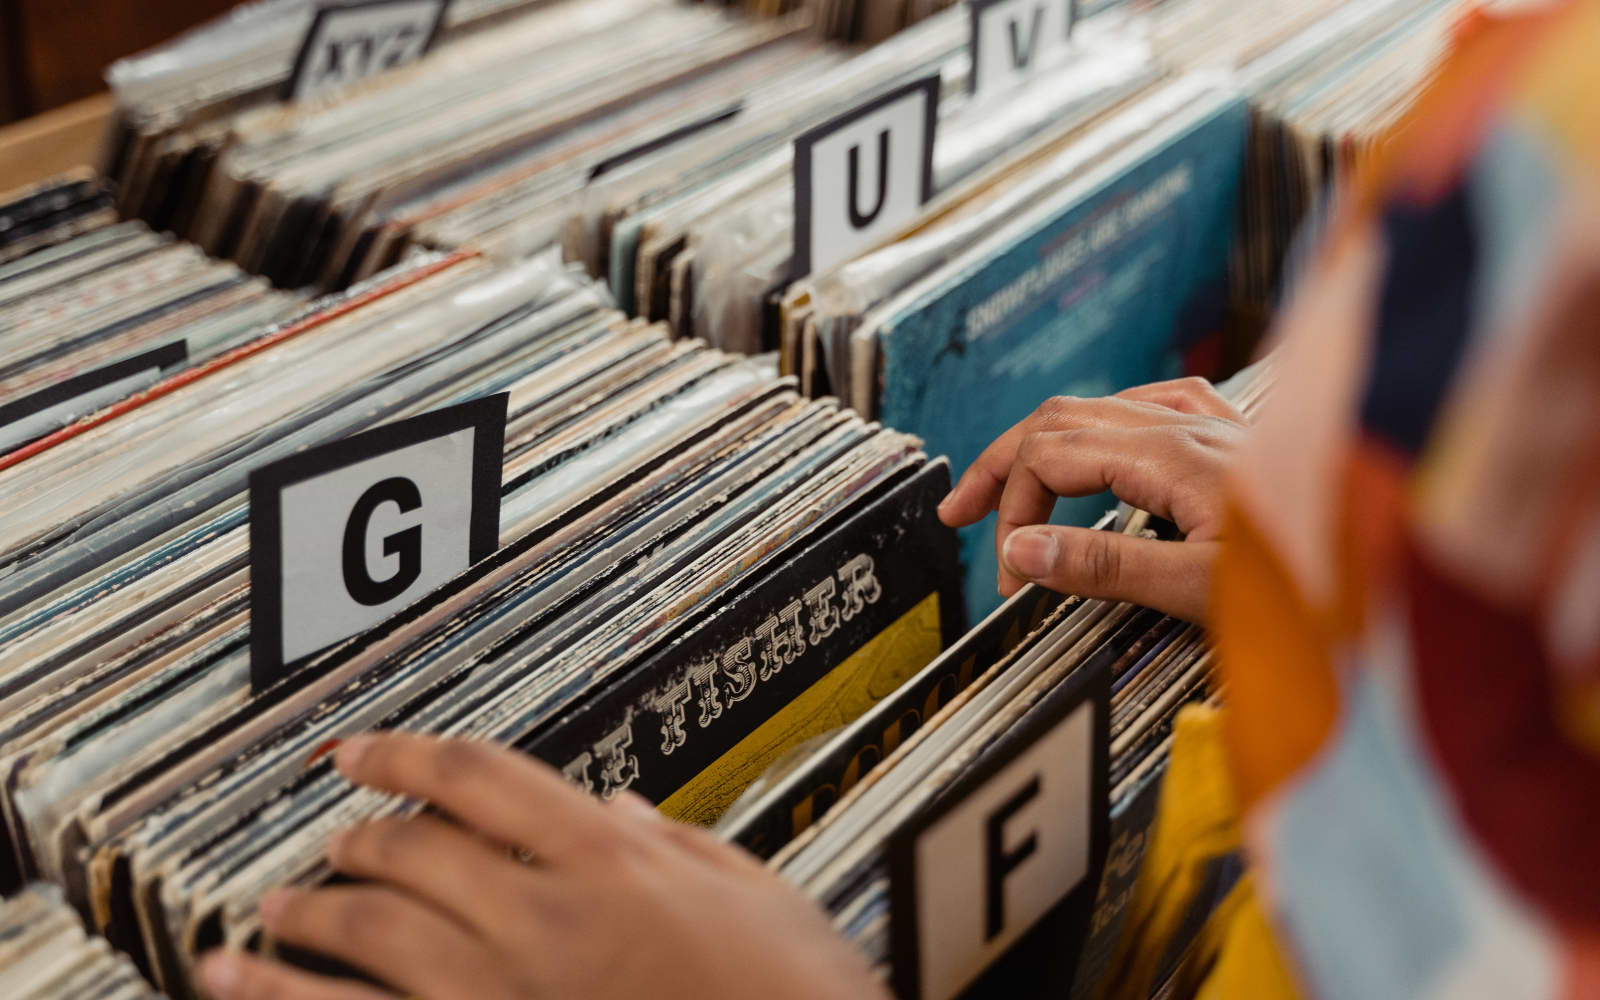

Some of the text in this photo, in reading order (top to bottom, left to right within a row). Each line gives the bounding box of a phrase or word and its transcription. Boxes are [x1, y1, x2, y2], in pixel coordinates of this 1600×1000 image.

[315, 24, 417, 86] XYZ
[1007, 5, 1045, 69] V
[848, 128, 890, 229] U
[342, 476, 422, 606] G
[657, 553, 882, 756] FISHER
[983, 772, 1041, 946] F
